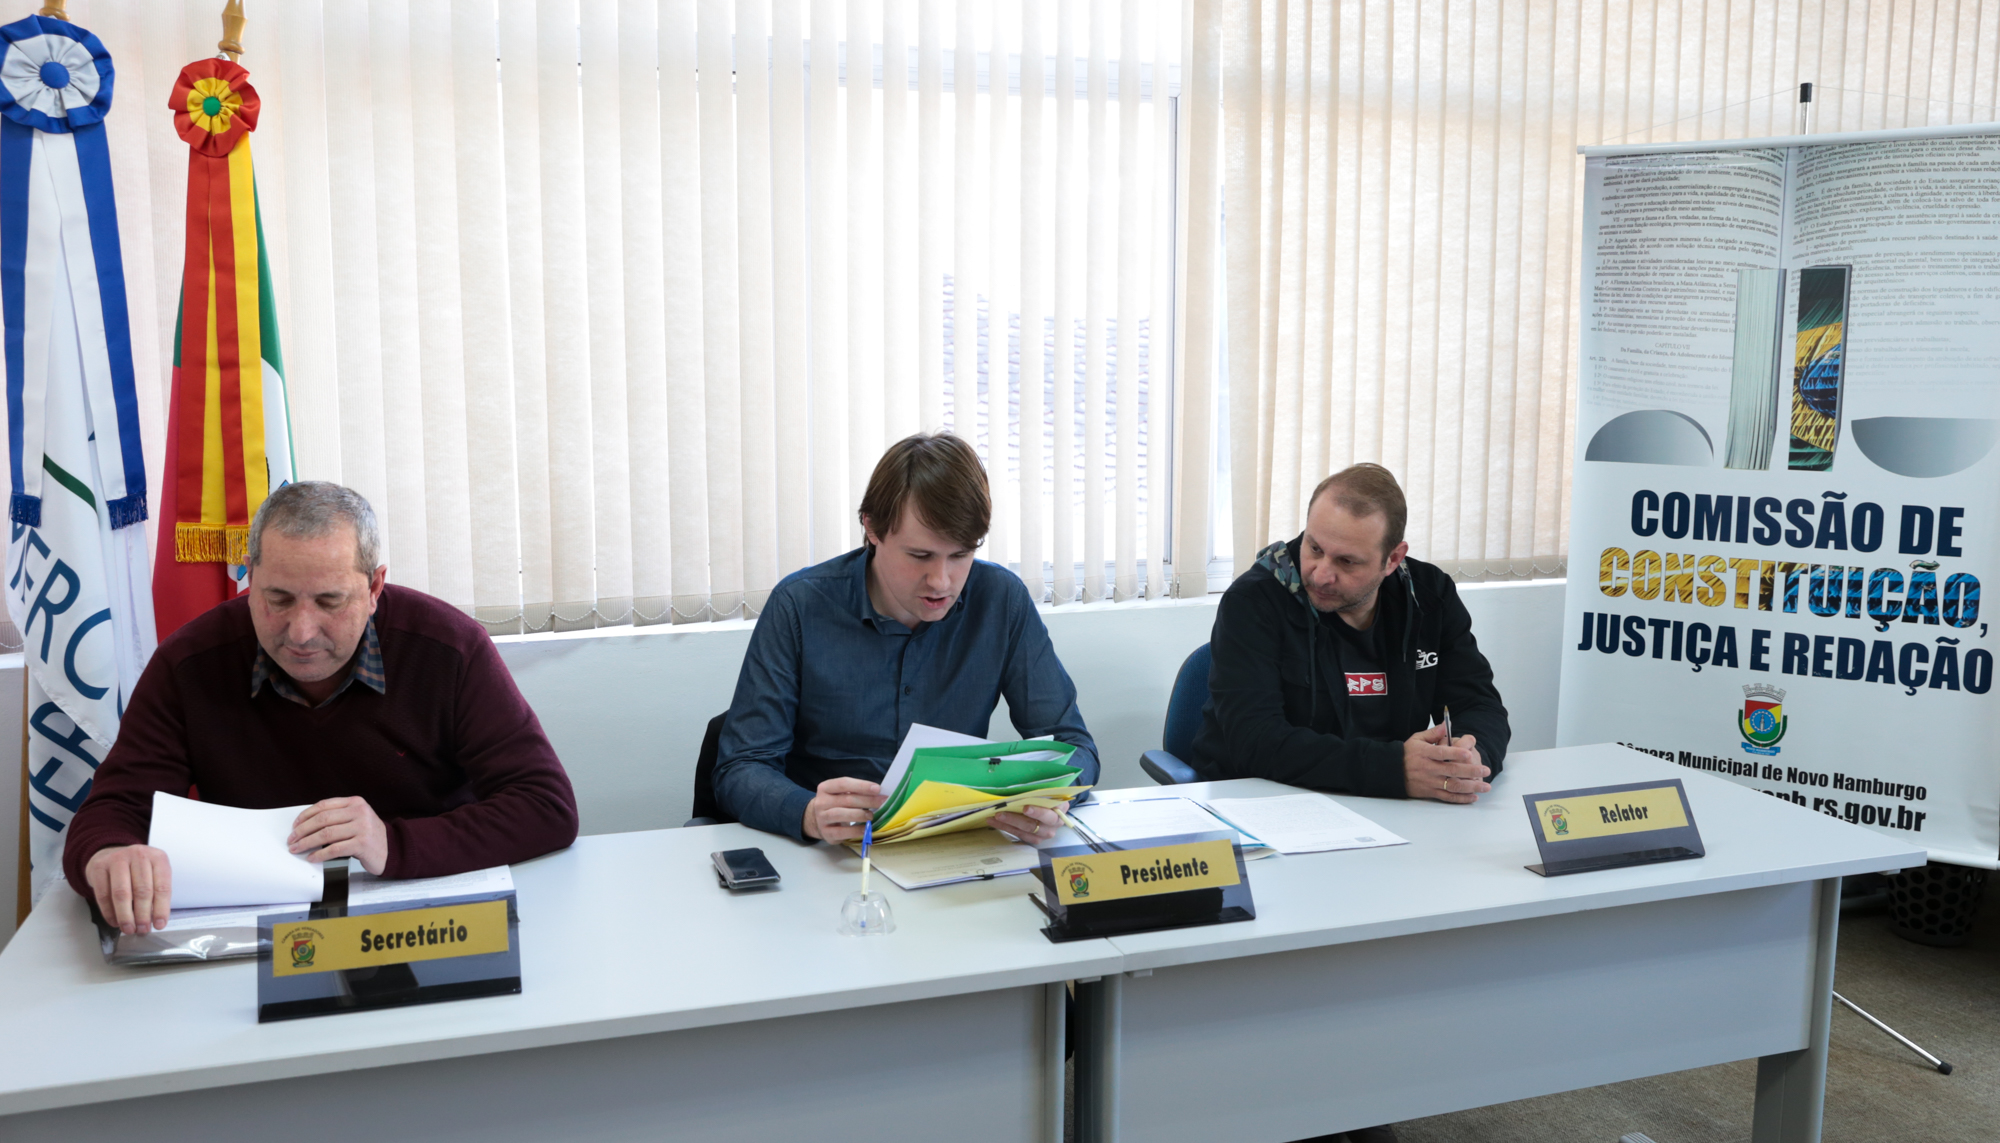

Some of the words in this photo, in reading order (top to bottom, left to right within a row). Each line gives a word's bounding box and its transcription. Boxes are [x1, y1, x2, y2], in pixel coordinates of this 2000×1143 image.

[1630, 490, 1884, 552] COMISSÃO
[1898, 504, 1965, 558] DE
[1598, 546, 1988, 638] CONSTITUIÇÃO,
[1578, 612, 1739, 673] JUSTIÇA
[1750, 628, 1772, 672] E
[1782, 635, 1994, 696] REDAÇÃO
[1678, 750, 1758, 778] Municipal
[1762, 764, 1782, 781] de
[1787, 766, 1828, 787] Novo
[1833, 772, 1926, 801] Hamburgo
[1599, 804, 1648, 823] Relator
[1120, 858, 1209, 885] Presidente
[360, 919, 468, 952] Secretário
